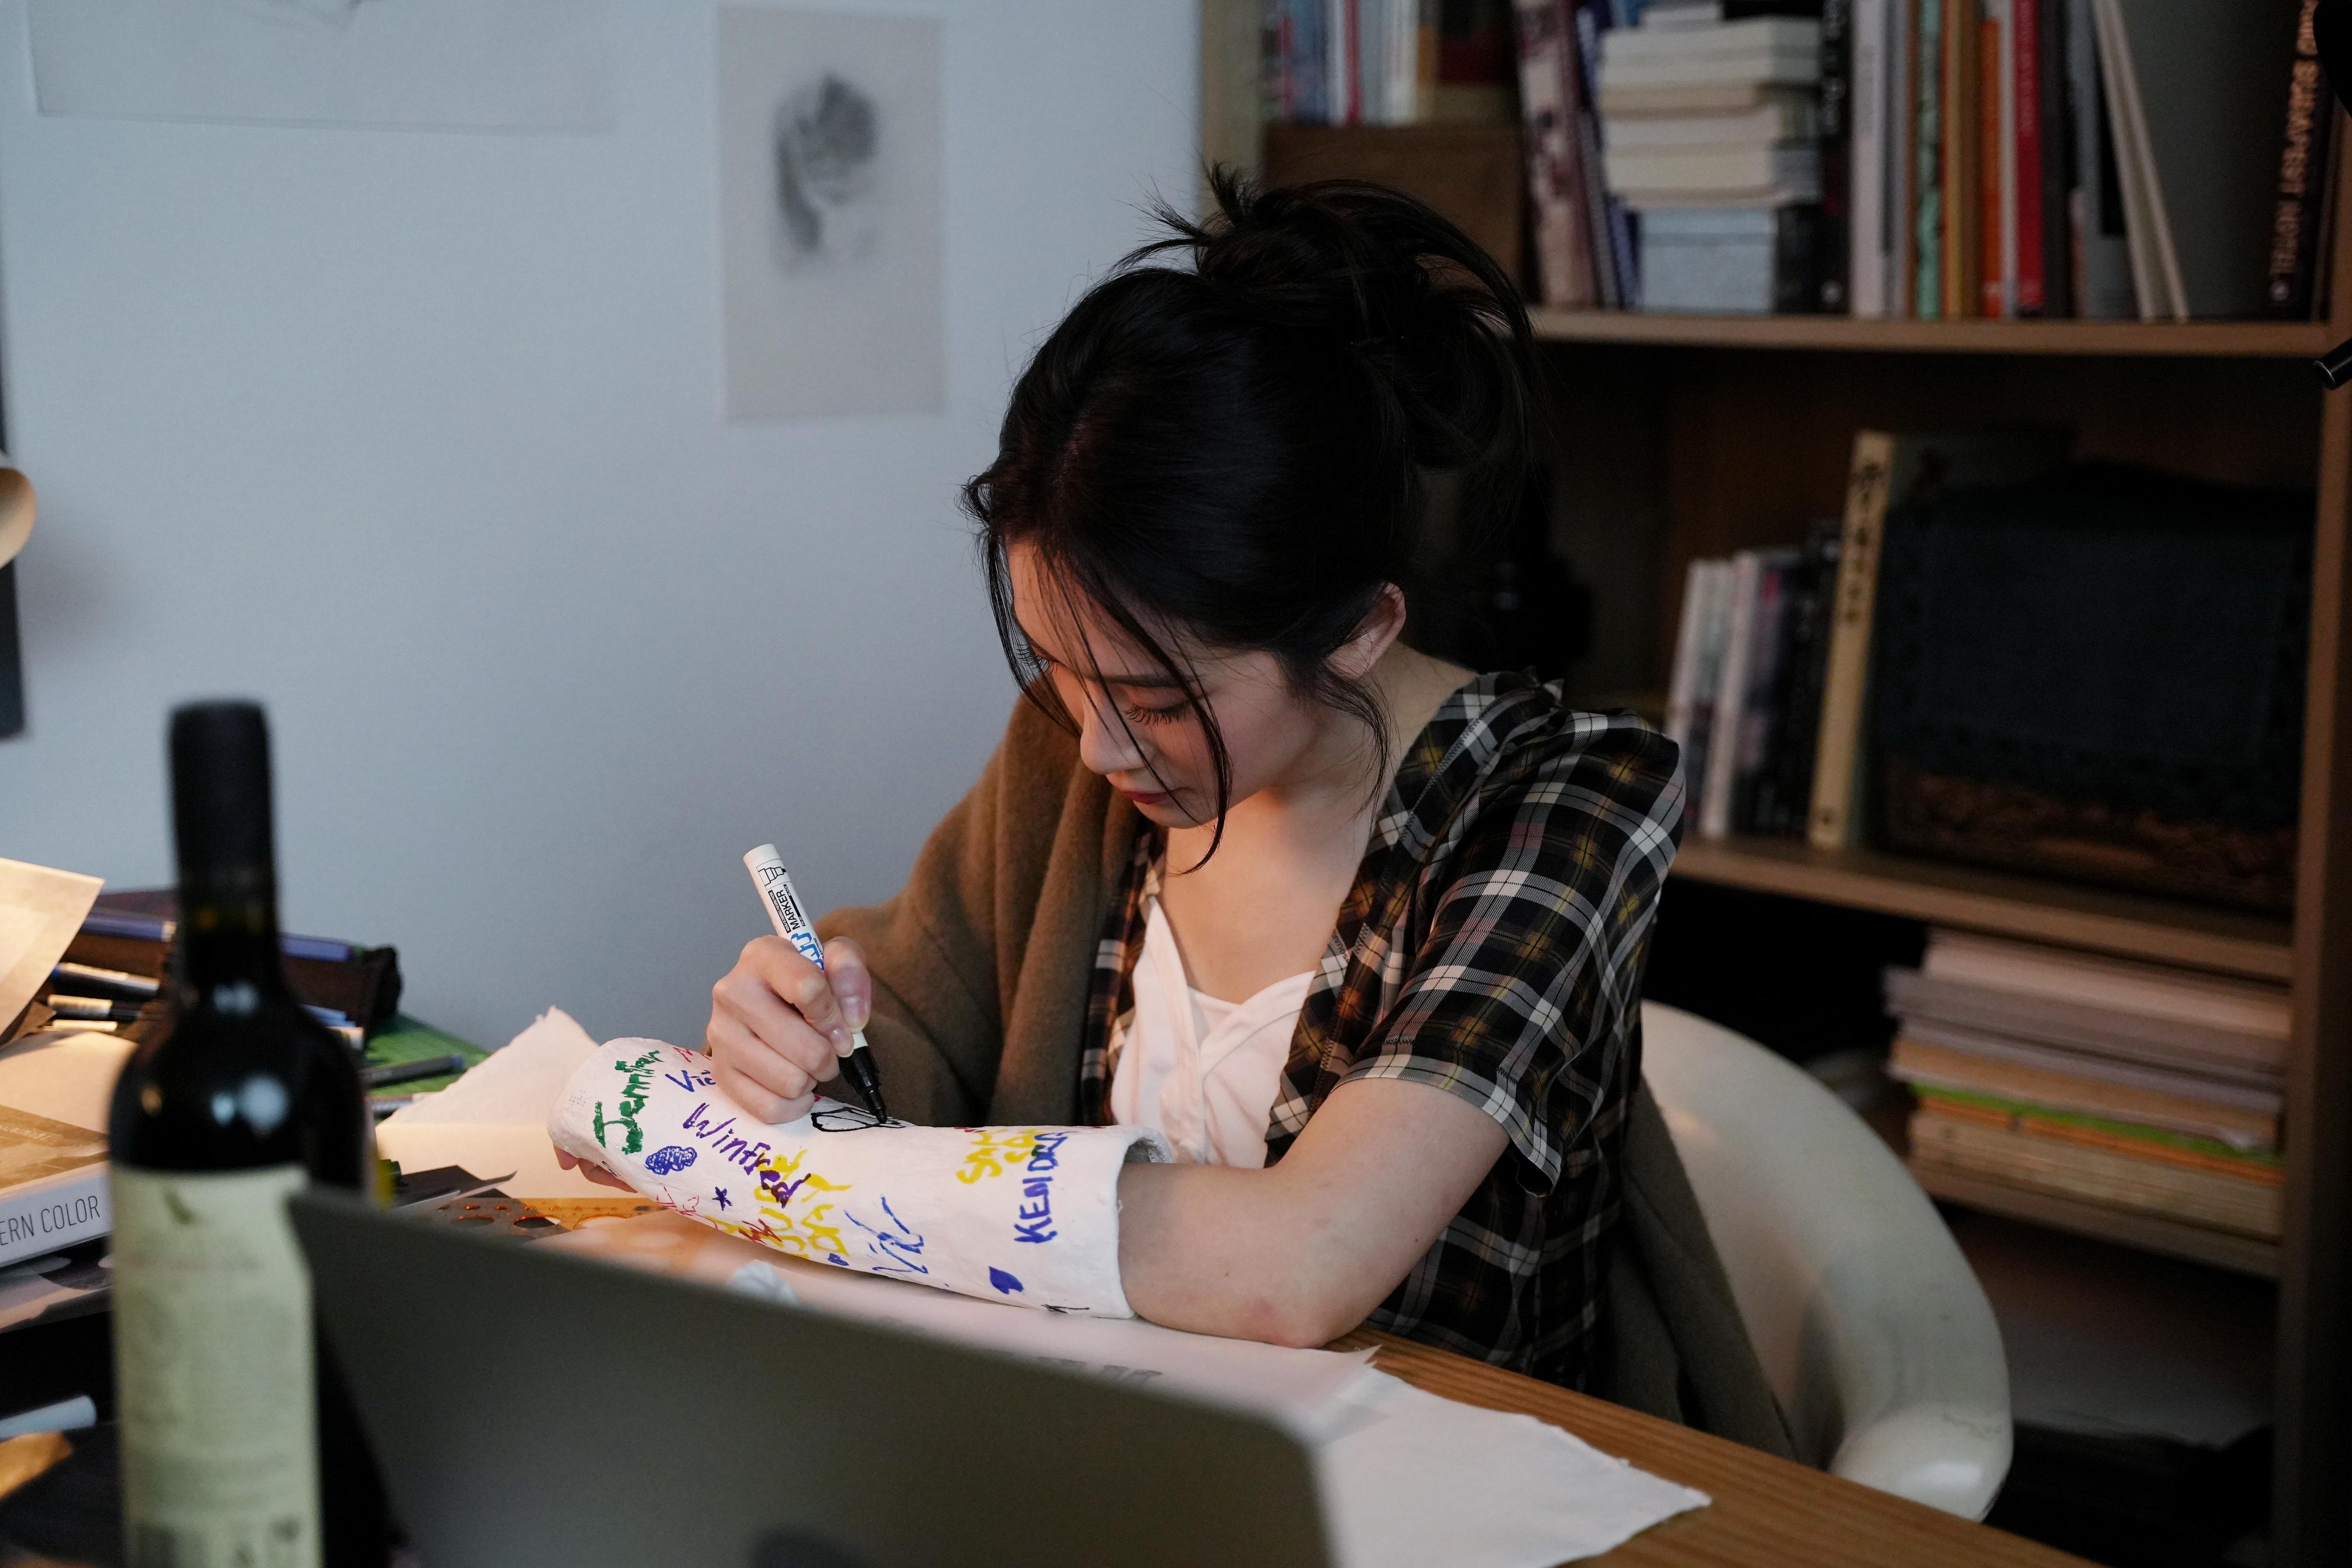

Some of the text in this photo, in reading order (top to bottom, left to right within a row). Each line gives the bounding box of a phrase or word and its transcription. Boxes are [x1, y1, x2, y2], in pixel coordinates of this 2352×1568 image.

[775, 890, 800, 930] MARKER
[813, 938, 823, 955] ANYTHING
[41, 1196, 100, 1233] COLOR
